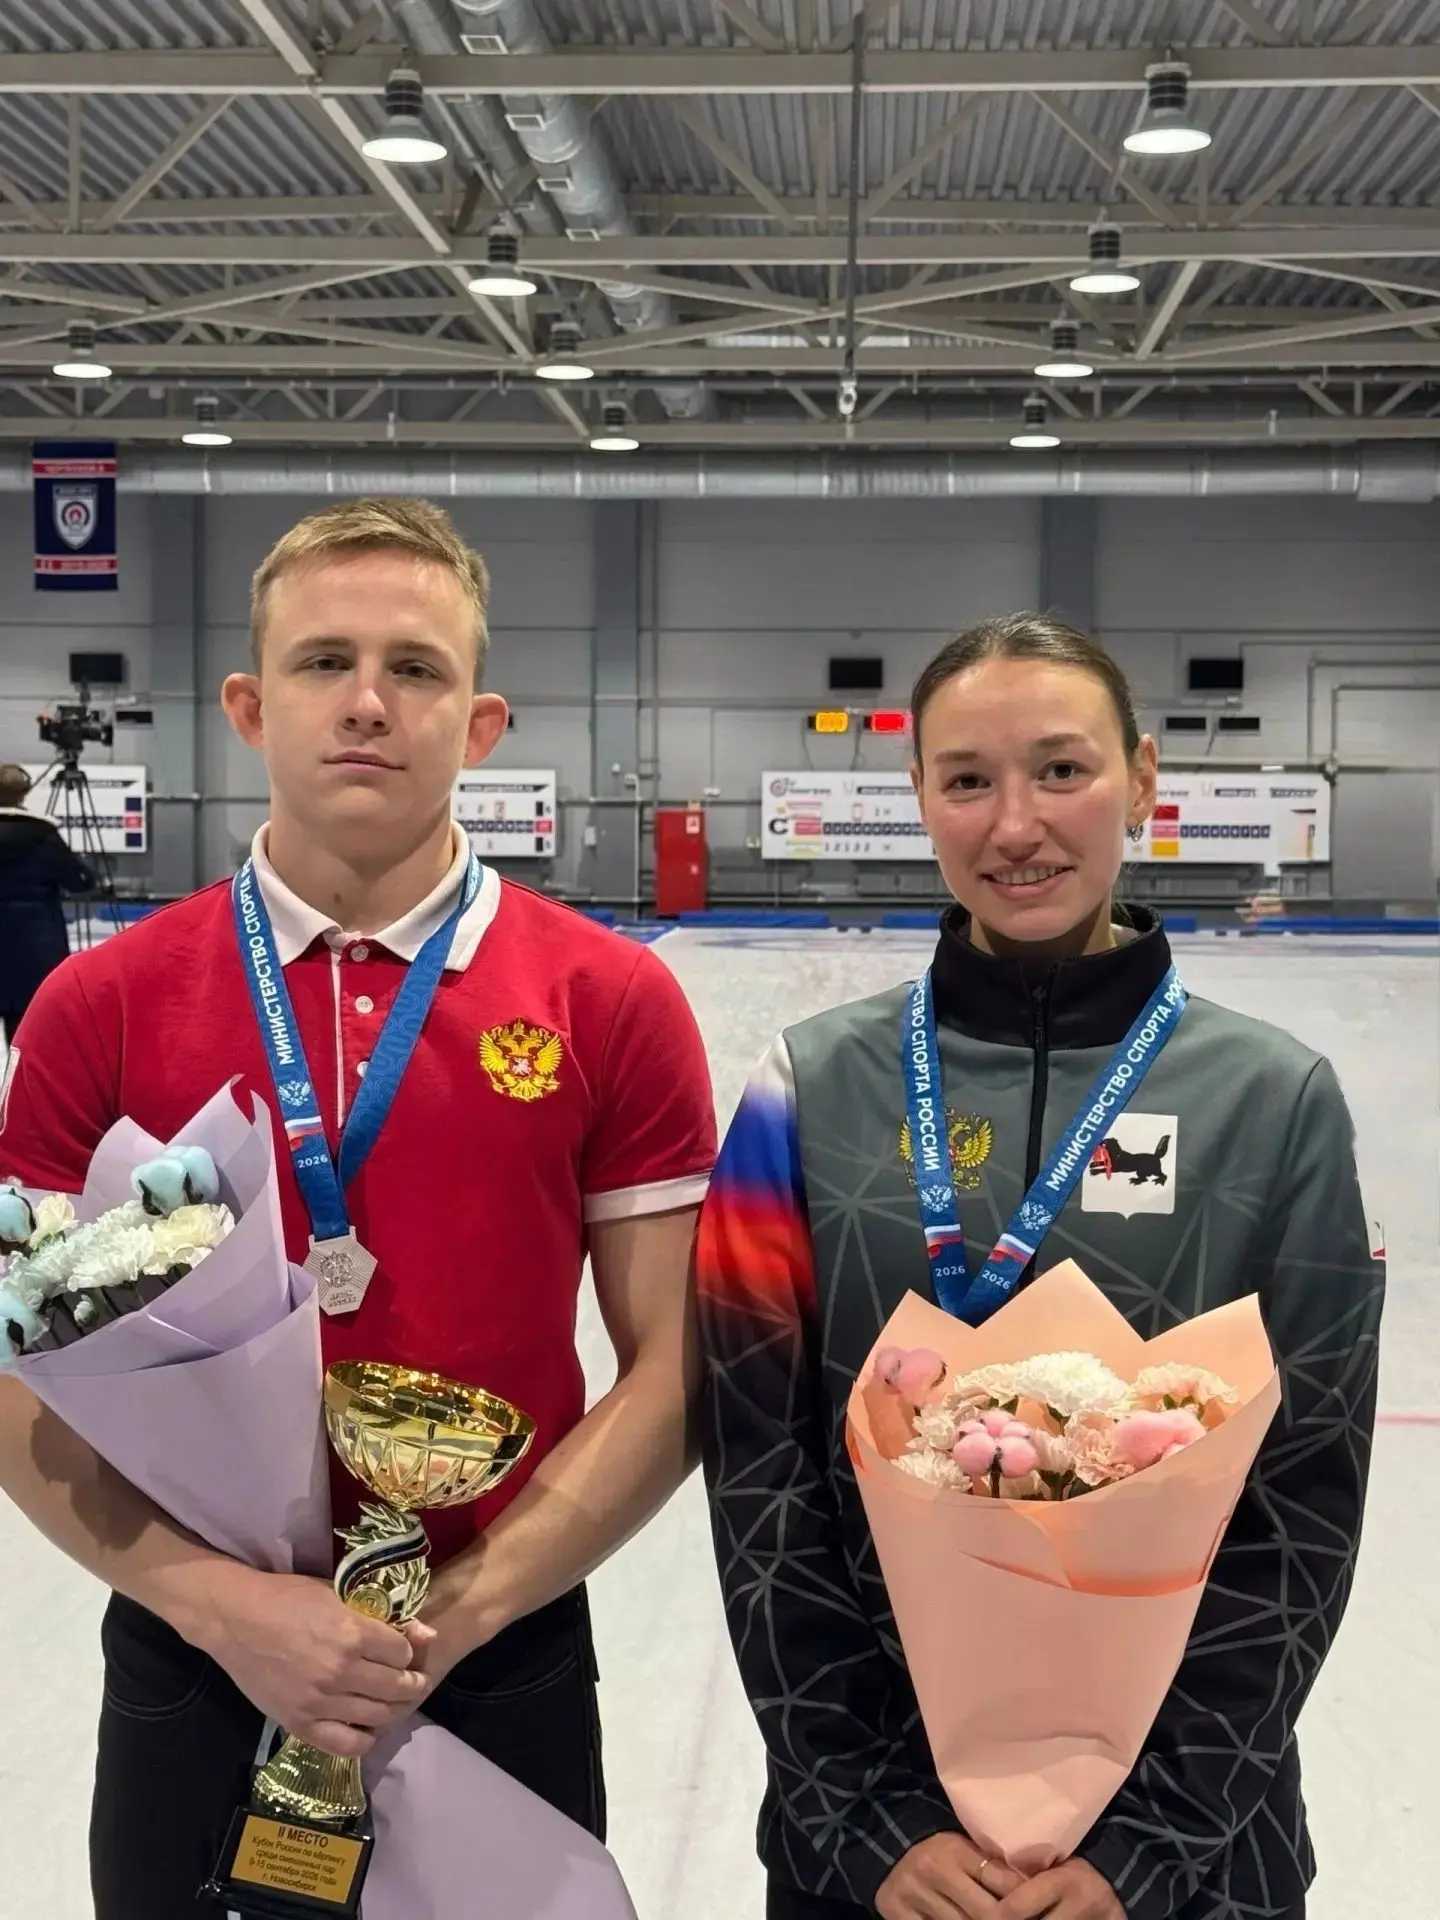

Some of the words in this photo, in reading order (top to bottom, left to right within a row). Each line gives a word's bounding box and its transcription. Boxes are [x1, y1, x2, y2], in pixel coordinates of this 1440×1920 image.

[240, 874, 261, 933] СПОРТА
[248, 935, 295, 1066] МИНИСТЕРСТВО
[912, 1029, 931, 1094] СПОРТА
[1045, 1063, 1134, 1191] МИНИСТЕРСТВО
[1127, 1003, 1172, 1063] СПОРТА
[916, 1097, 941, 1172] РОССИИ
[297, 1154, 328, 1168] 2026
[935, 1265, 966, 1277] 2026
[982, 1269, 1012, 1290] 2026
[251, 1835, 274, 1847] Кубок
[275, 1840, 302, 1853] России
[286, 1827, 329, 1848] МЕСТО
